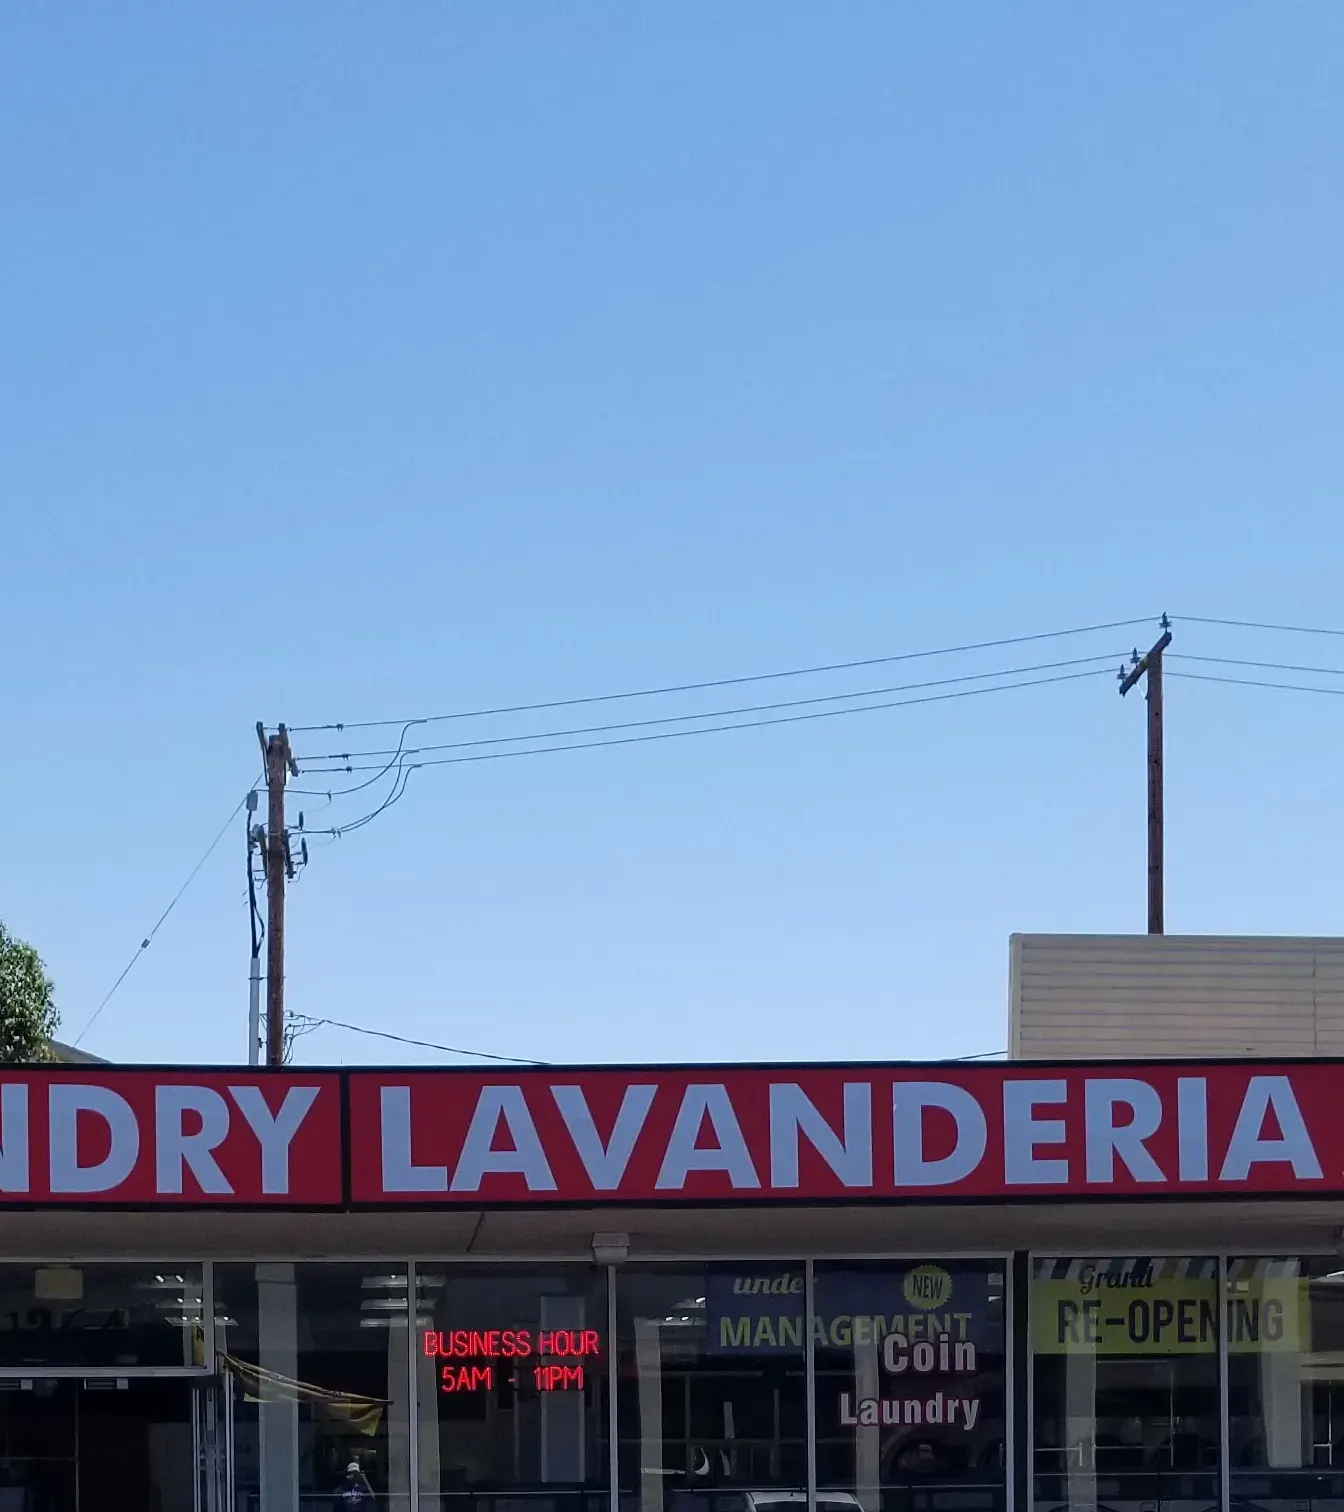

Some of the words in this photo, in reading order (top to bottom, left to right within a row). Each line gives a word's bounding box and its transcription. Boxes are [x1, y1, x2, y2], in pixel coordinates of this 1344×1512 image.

[381, 1076, 1323, 1191] LAVANDERIA
[734, 1274, 805, 1295] unde
[912, 1275, 942, 1300] NEW
[1079, 1264, 1154, 1295] Grand
[720, 1313, 973, 1348] MANAGEMENT
[1058, 1299, 1284, 1343] RE-OPENING
[423, 1330, 532, 1358] BUSINESS
[539, 1330, 600, 1357] HOUR
[883, 1333, 977, 1373] Coin
[441, 1365, 492, 1393] 5AM
[533, 1365, 584, 1392] 11PM
[839, 1392, 980, 1431] Laundry
